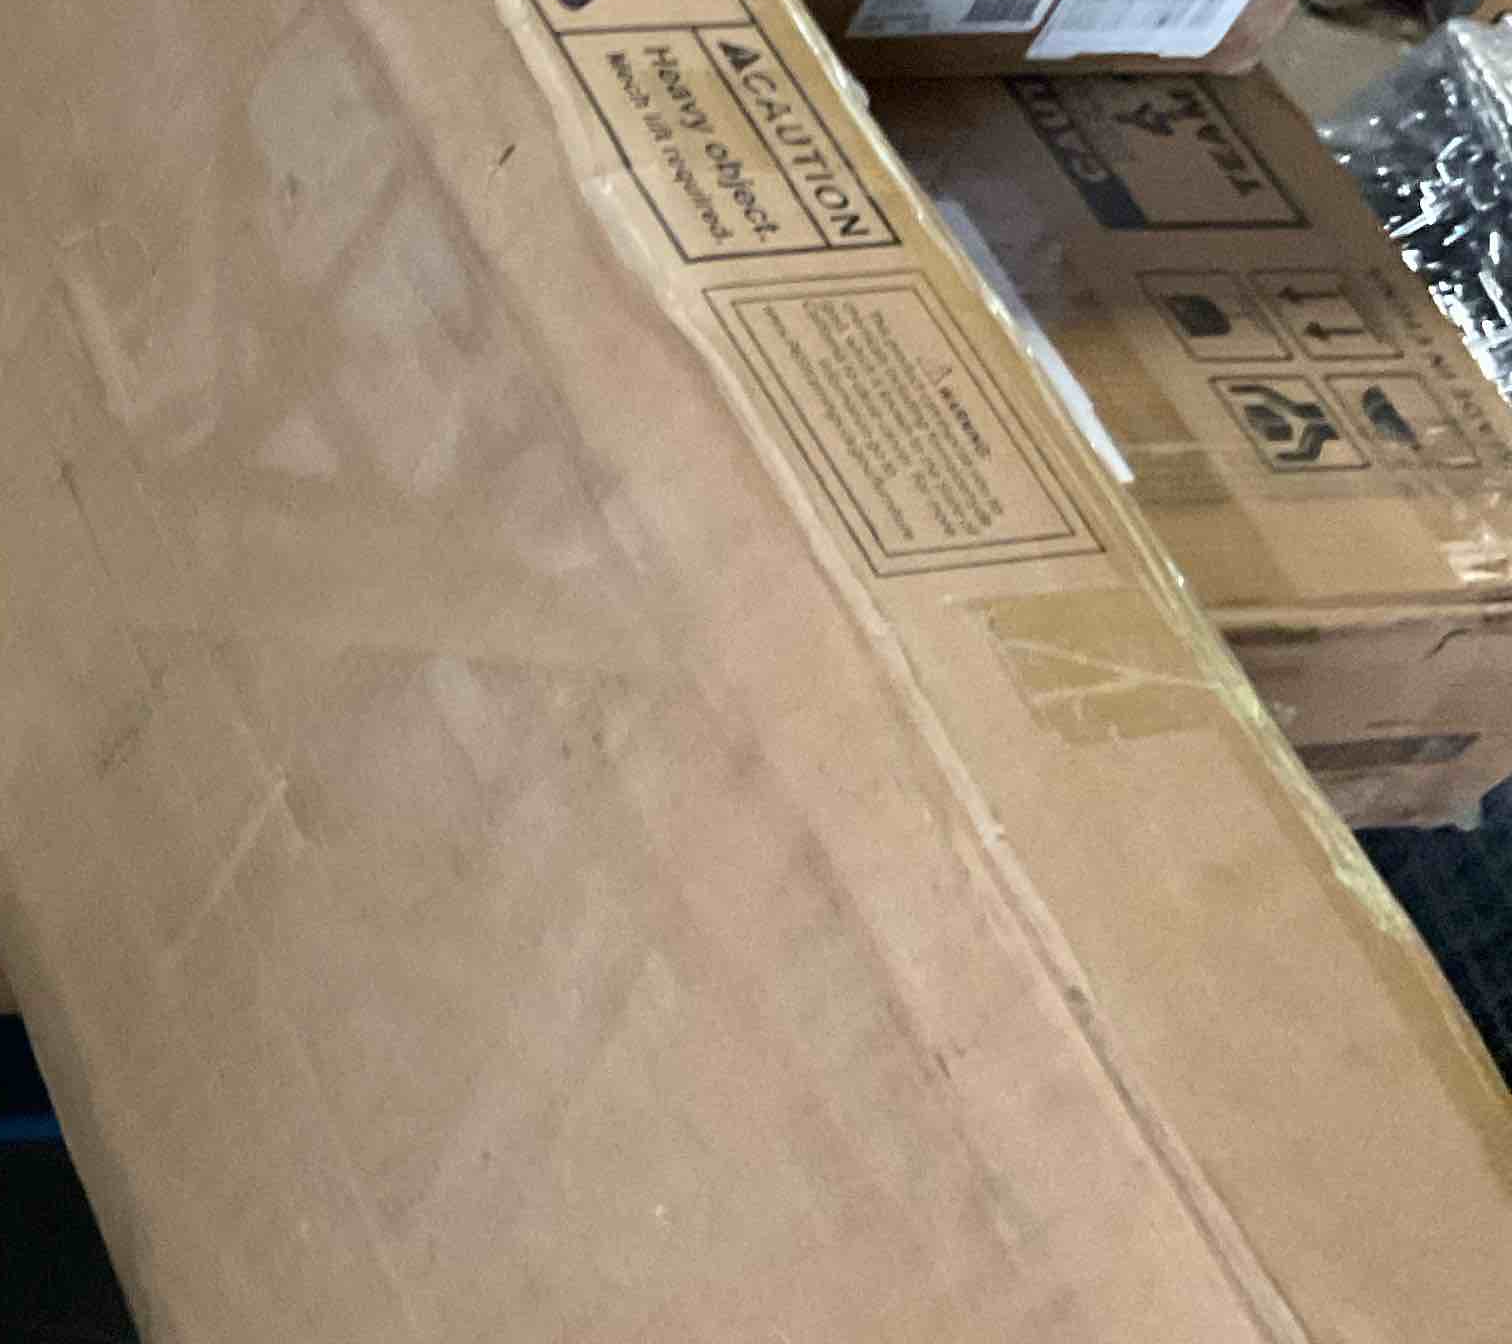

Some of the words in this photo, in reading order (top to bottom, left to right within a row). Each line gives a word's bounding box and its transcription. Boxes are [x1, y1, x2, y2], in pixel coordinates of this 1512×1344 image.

[643, 44, 714, 135] Heavy
[705, 143, 781, 243] object.
[741, 70, 871, 238] CAUTION
